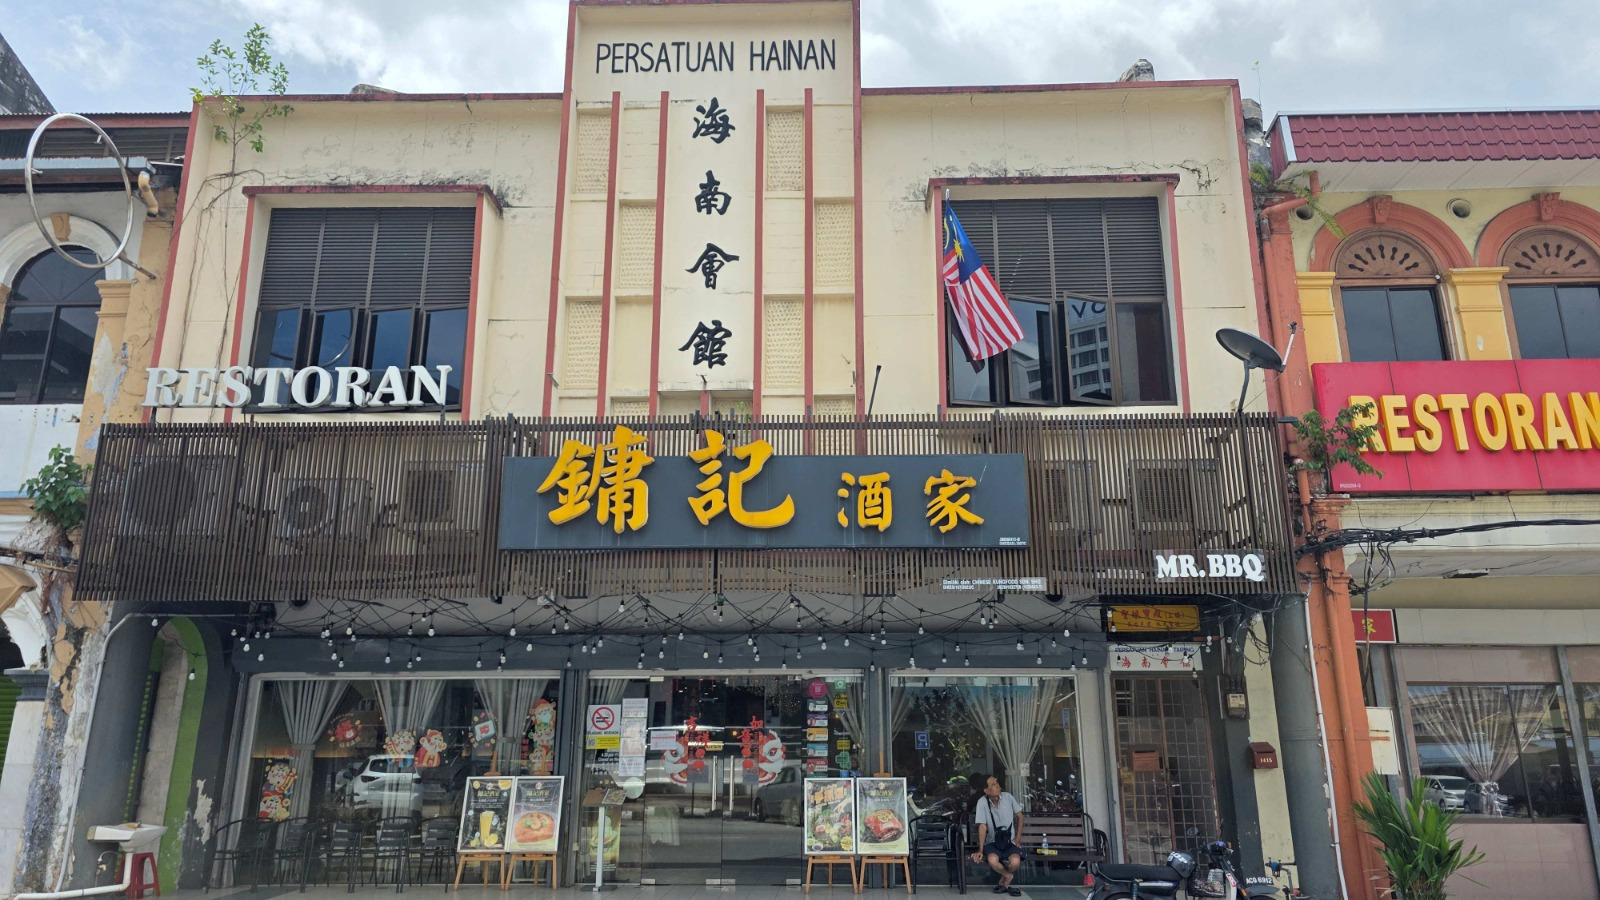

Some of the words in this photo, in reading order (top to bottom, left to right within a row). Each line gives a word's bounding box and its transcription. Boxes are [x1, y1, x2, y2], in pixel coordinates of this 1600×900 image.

[596, 41, 734, 73] PERSATUAN
[750, 39, 836, 71] HAINAN
[678, 97, 740, 369] 海南會館
[141, 365, 453, 408] RESTORAN
[536, 424, 985, 534] 鏞記酒家
[1156, 554, 1206, 579] MR.
[1207, 553, 1265, 582] BBQ
